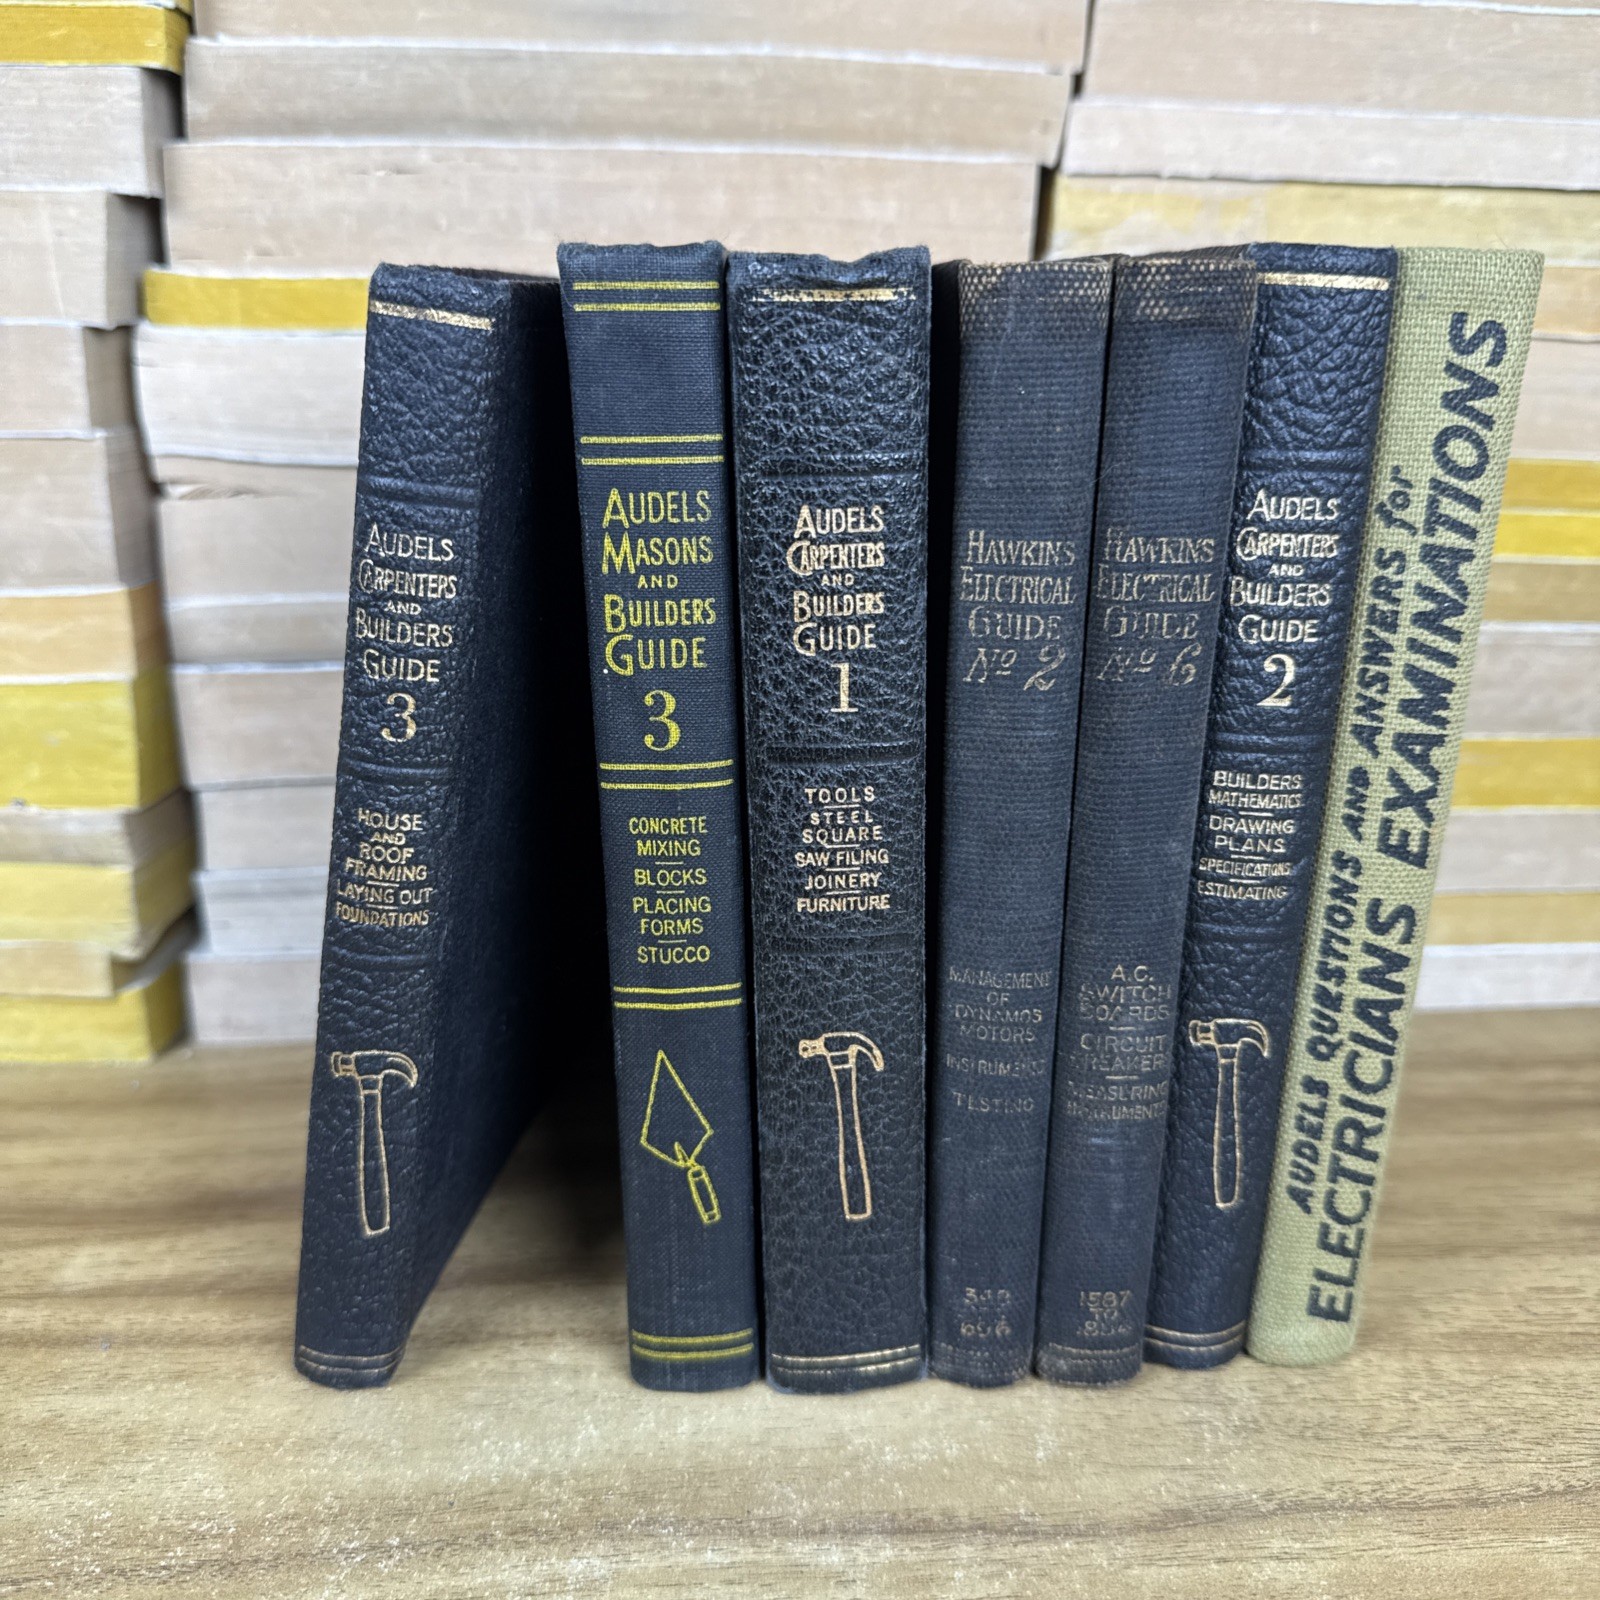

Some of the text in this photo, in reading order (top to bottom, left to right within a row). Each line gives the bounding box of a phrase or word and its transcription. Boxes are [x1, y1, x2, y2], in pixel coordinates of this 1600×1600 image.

[602, 487, 711, 529] AUDELS
[1246, 488, 1340, 521] AUDELS
[793, 504, 885, 538] AUDELS
[364, 521, 454, 562] AUDELS
[601, 530, 714, 575] MASONS
[966, 529, 1075, 566] HAWKINS
[1104, 527, 1215, 564] HAWKINS
[1235, 526, 1340, 561] CARPENTERS
[786, 539, 886, 576] CARPENTERS
[1268, 563, 1305, 578] AND
[358, 558, 458, 599] CARPENTERS
[637, 574, 679, 589] AND
[820, 573, 855, 587] AND
[1229, 575, 1332, 608] BUILDERS
[384, 600, 422, 616] AND
[604, 593, 717, 634] BUILDERS
[793, 590, 885, 623] BUILDERS
[355, 606, 454, 648] BUILDERS
[968, 605, 1062, 641] GUIDE
[1238, 614, 1321, 645] GUIDE
[792, 622, 877, 657] GUIDE
[362, 648, 441, 683] GUIDE
[604, 633, 708, 677] GUIDE
[1023, 644, 1066, 691] 2
[1168, 642, 1202, 686] 6
[830, 661, 859, 713] 1
[1256, 653, 1295, 707] 2
[380, 692, 417, 743] 3
[643, 689, 682, 751] 3
[1212, 770, 1303, 790] BUILDERS
[804, 786, 875, 804] TOOLS
[1208, 789, 1304, 809] MATHEMATICS
[357, 807, 424, 831] HOUSE
[628, 816, 708, 835] CONCRETE
[810, 810, 874, 825] STEEL
[1208, 814, 1296, 835] DRAWING
[1307, 311, 1507, 1323] ELECTRICIANS EXAMINATIONS
[369, 832, 406, 846] AND
[636, 839, 702, 857] MIXING
[801, 825, 884, 846] SQUARE
[1214, 835, 1287, 853] PLANS
[1286, 463, 1419, 1213] AUDELS QUESTIONS AND ANSWERS for
[360, 842, 415, 865] ROOF
[794, 848, 890, 868] SAW FILING
[344, 856, 428, 882] FRAMING
[633, 868, 708, 886] BLOCKS
[1199, 857, 1292, 877] SPECIFICATIONS
[337, 879, 434, 905] LAYING OUT
[804, 872, 882, 890] JOINERY
[1197, 879, 1289, 900] ESTIMATING
[335, 900, 430, 928] FOUNDATIONS
[632, 896, 712, 915] PLACING
[796, 894, 891, 913] FURNITURE
[640, 918, 704, 936] FORMS
[637, 945, 711, 965] STUCCO
[1111, 963, 1154, 983] A.C.
[986, 991, 1011, 1006] OF
[1080, 1032, 1167, 1053] CIRCUIT
